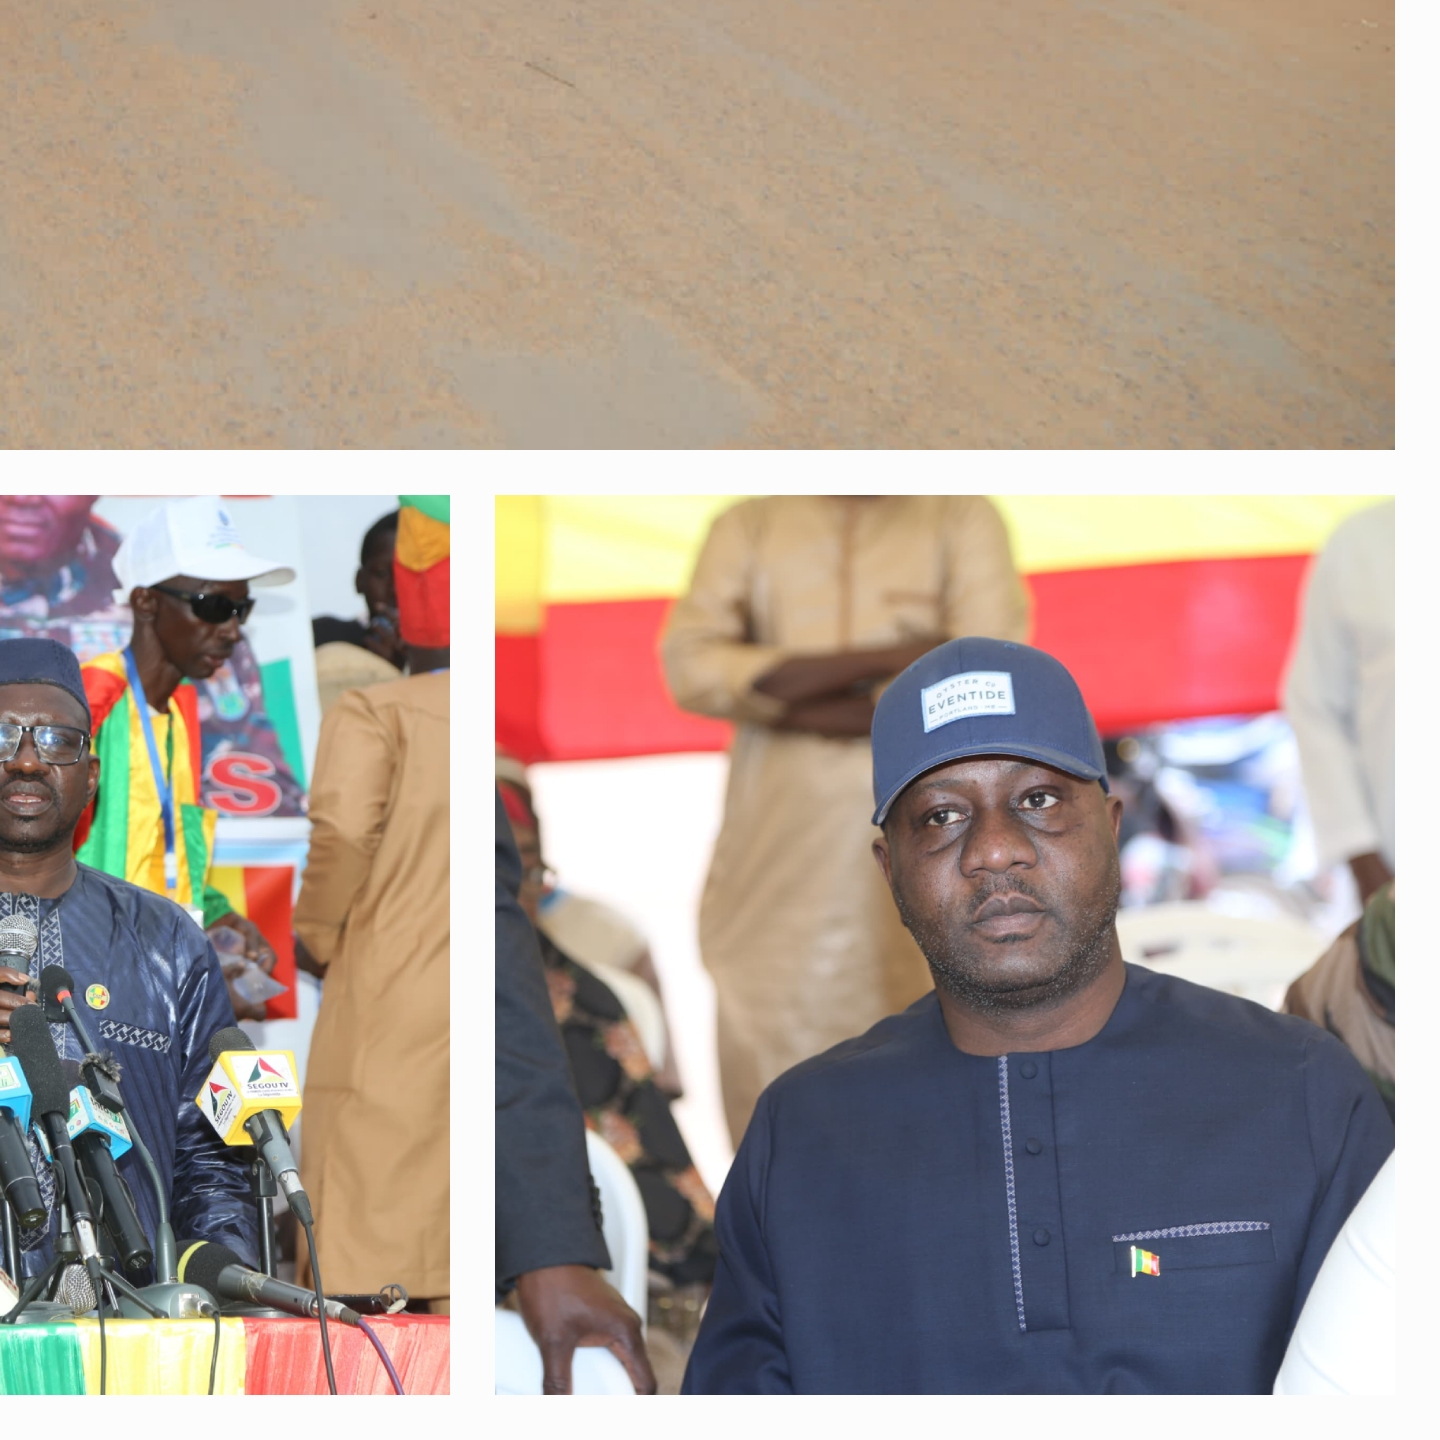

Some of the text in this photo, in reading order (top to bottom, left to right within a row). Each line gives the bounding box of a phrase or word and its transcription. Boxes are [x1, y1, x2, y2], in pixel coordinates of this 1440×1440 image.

[936, 678, 979, 698] OYSTER
[928, 690, 1006, 714] EVENTIDE
[247, 1082, 278, 1090] SEGOU
